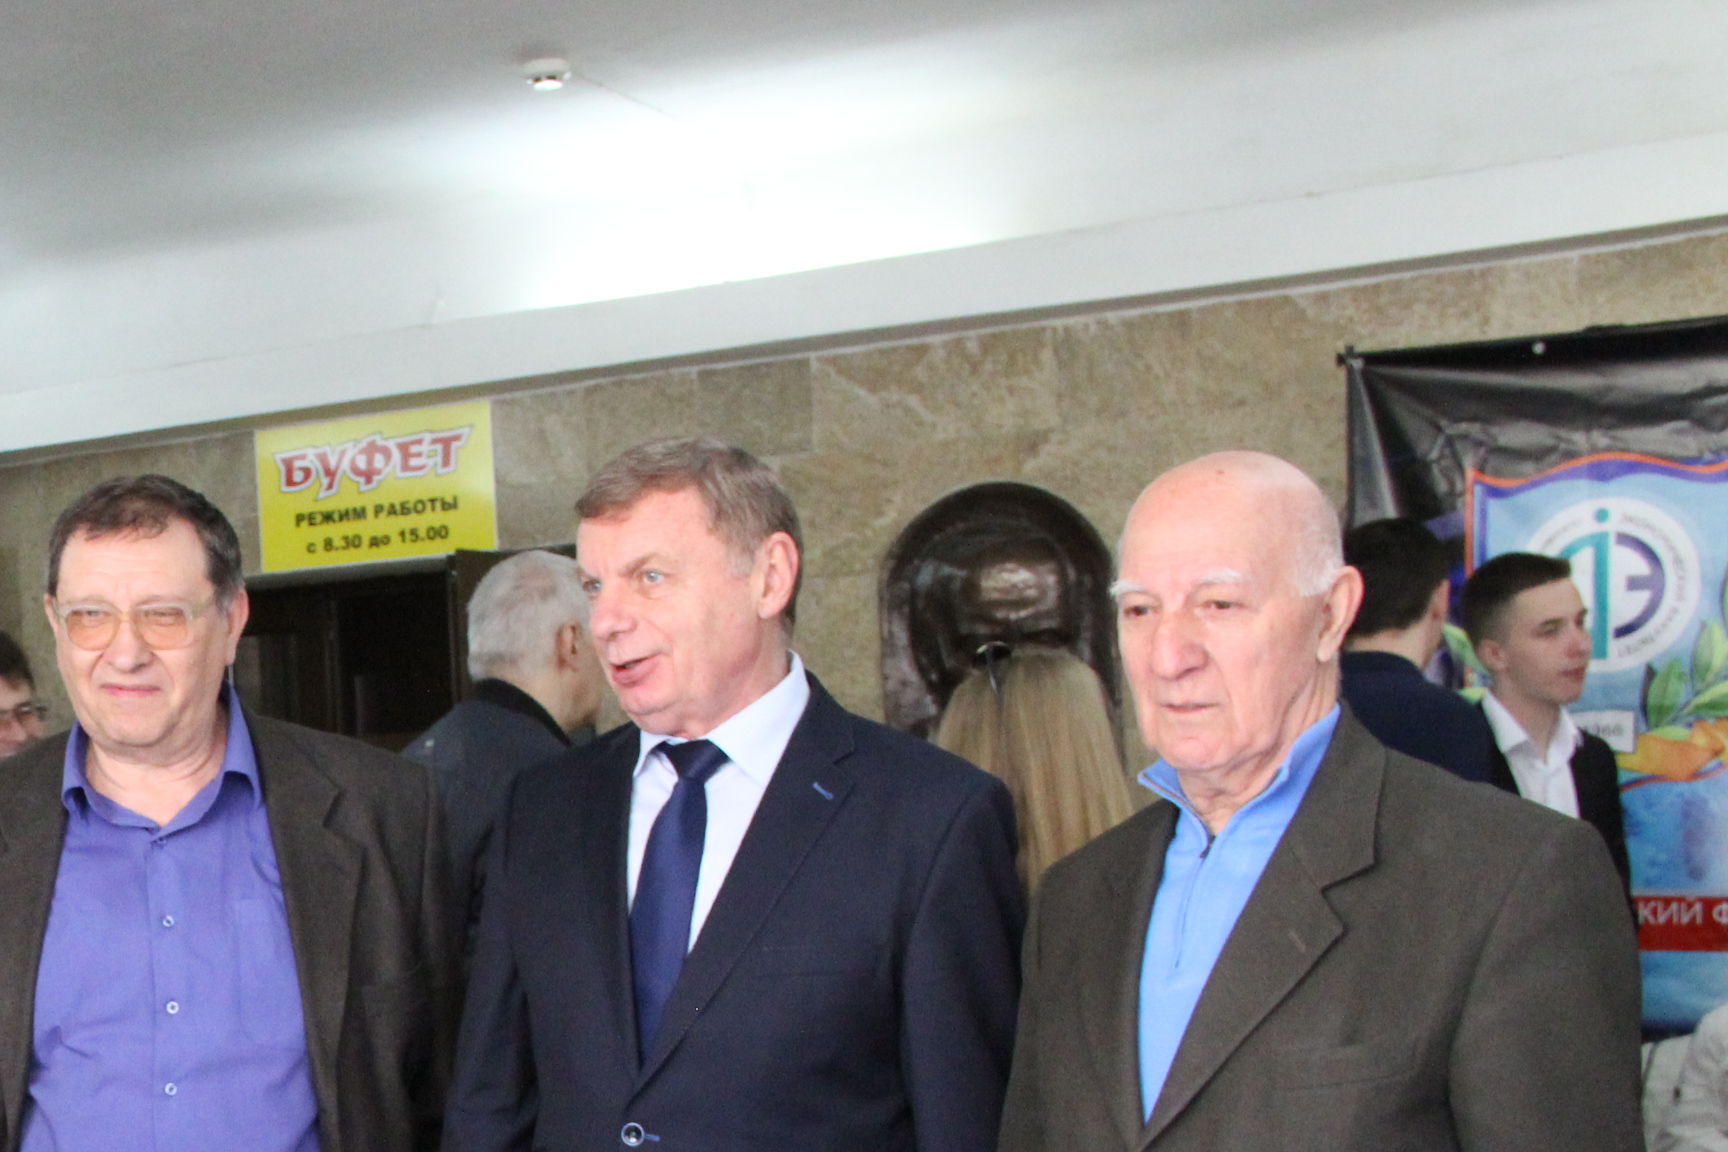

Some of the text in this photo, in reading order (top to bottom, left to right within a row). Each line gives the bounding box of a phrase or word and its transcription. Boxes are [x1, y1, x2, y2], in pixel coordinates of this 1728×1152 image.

[274, 426, 471, 499] БУФЕТ
[295, 496, 459, 528] РЕЖИМ РАБОТЫ
[306, 524, 450, 554] с 8.30 до 15.00
[1638, 896, 1704, 925] КИЙ
